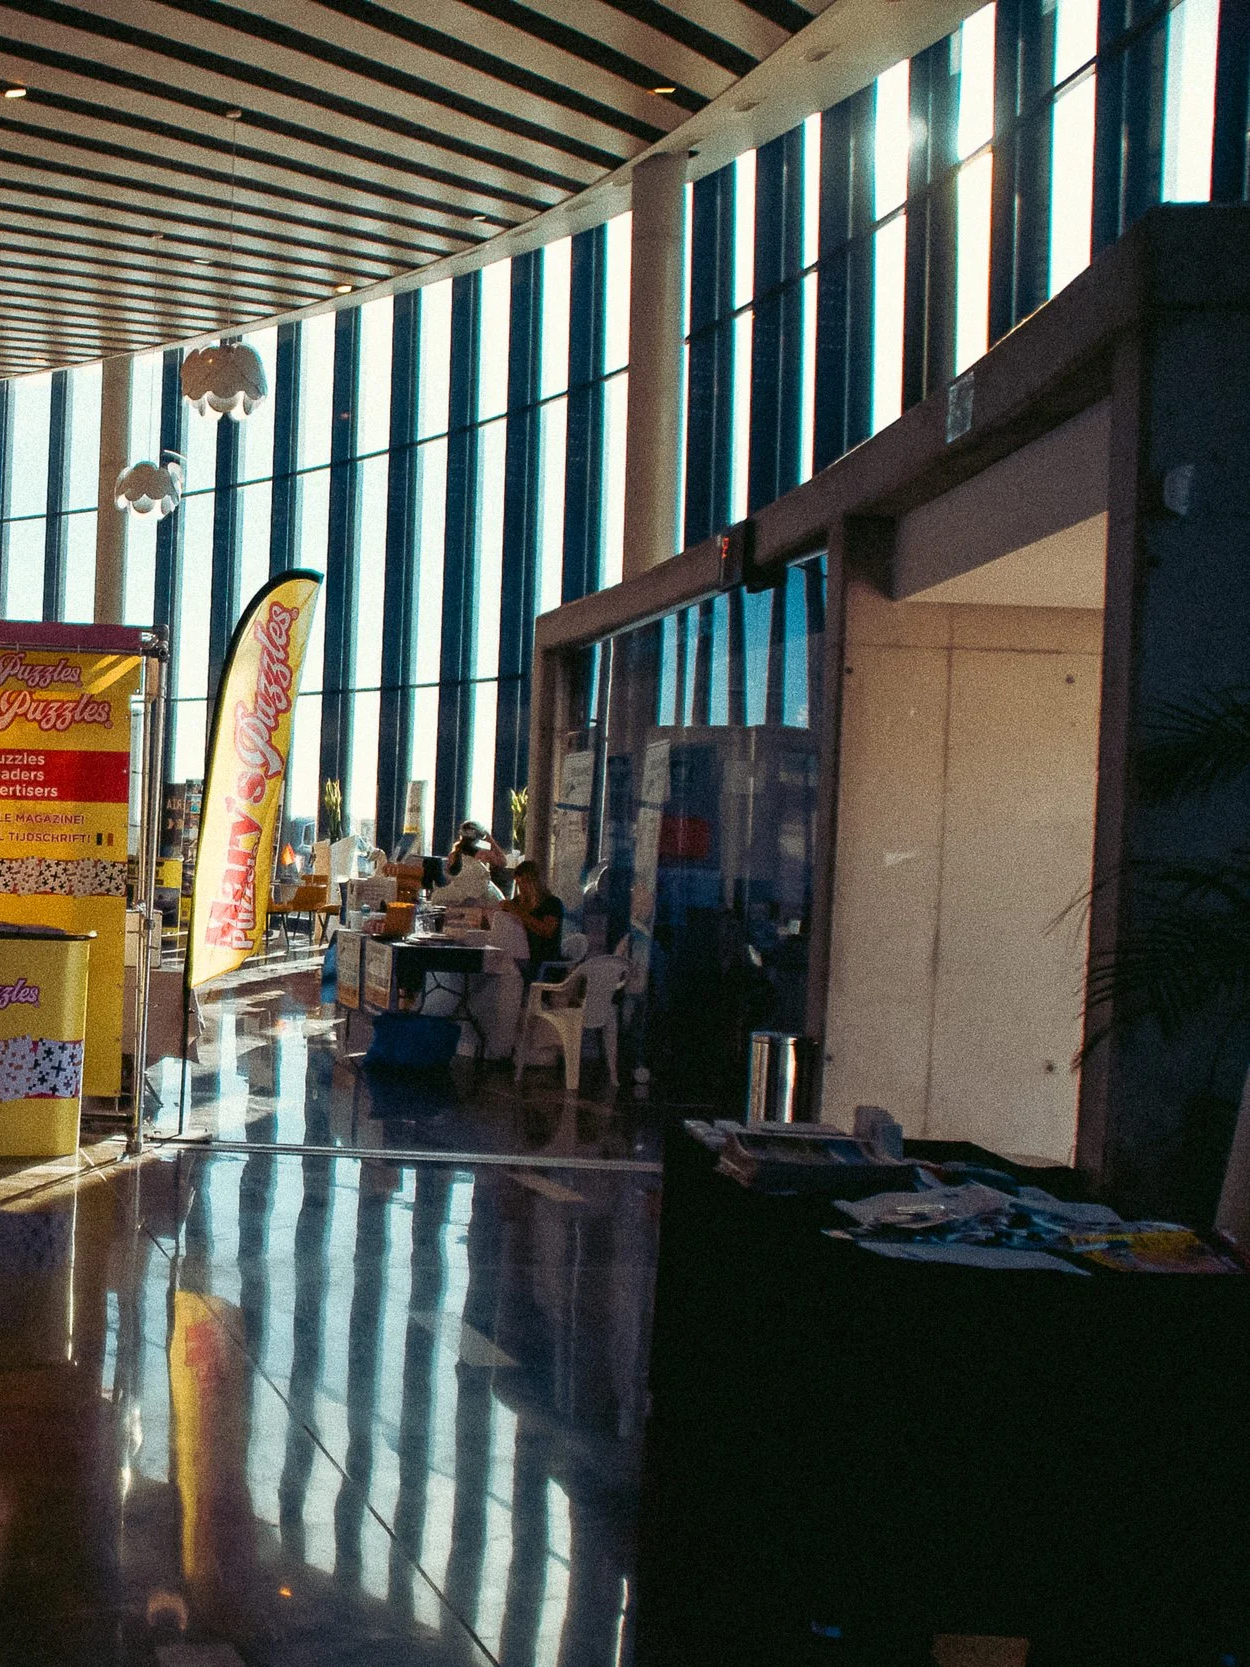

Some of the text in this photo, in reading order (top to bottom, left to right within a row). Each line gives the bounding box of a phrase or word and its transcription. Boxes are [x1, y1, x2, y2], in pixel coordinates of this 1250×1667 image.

[205, 601, 293, 948] Mary's Puzzles
[16, 813, 85, 825] MAGAZINE!
[8, 832, 91, 844] TIJDSCHRIFT!
